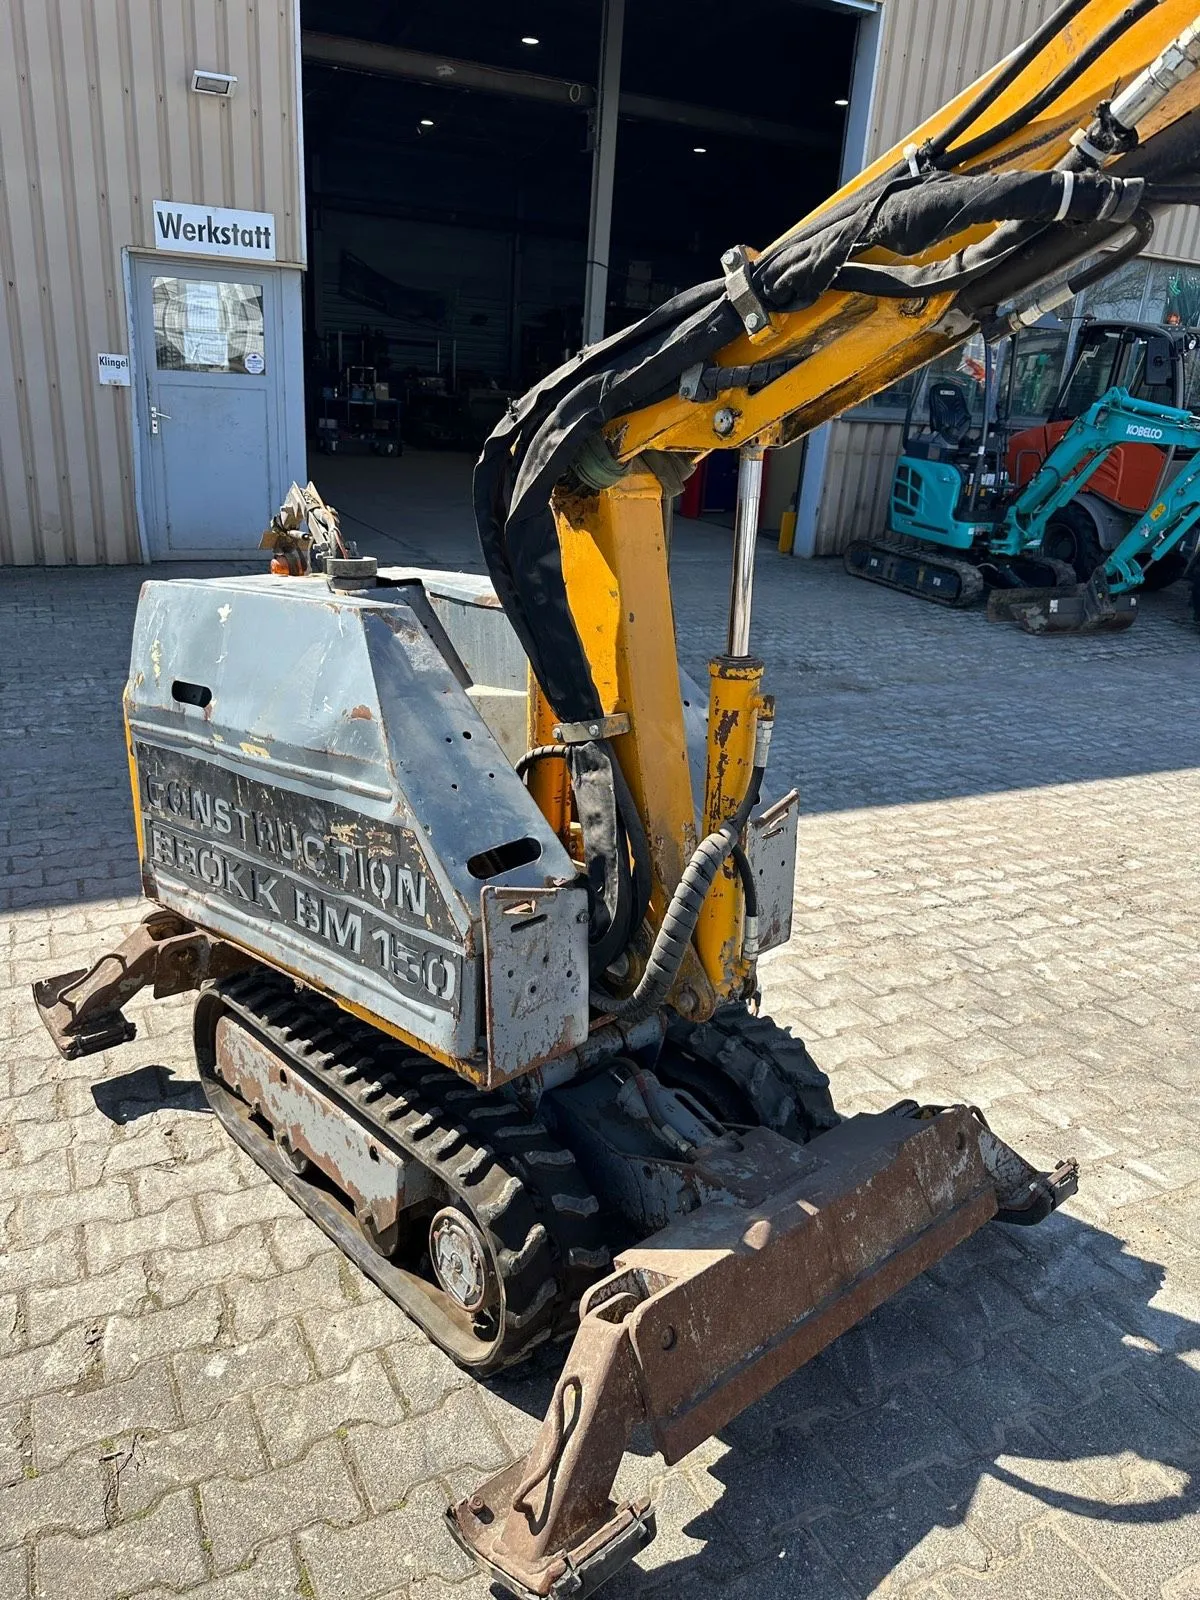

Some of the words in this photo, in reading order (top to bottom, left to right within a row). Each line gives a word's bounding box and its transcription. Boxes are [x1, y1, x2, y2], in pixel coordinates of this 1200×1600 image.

[156, 211, 272, 249] Werkstatt
[99, 356, 129, 369] Klingel
[1126, 424, 1162, 439] KOBELCO
[146, 772, 426, 917] CONSTRUCTION
[151, 828, 281, 917] BROKK
[293, 886, 362, 955] BM
[372, 927, 456, 1001] 150
